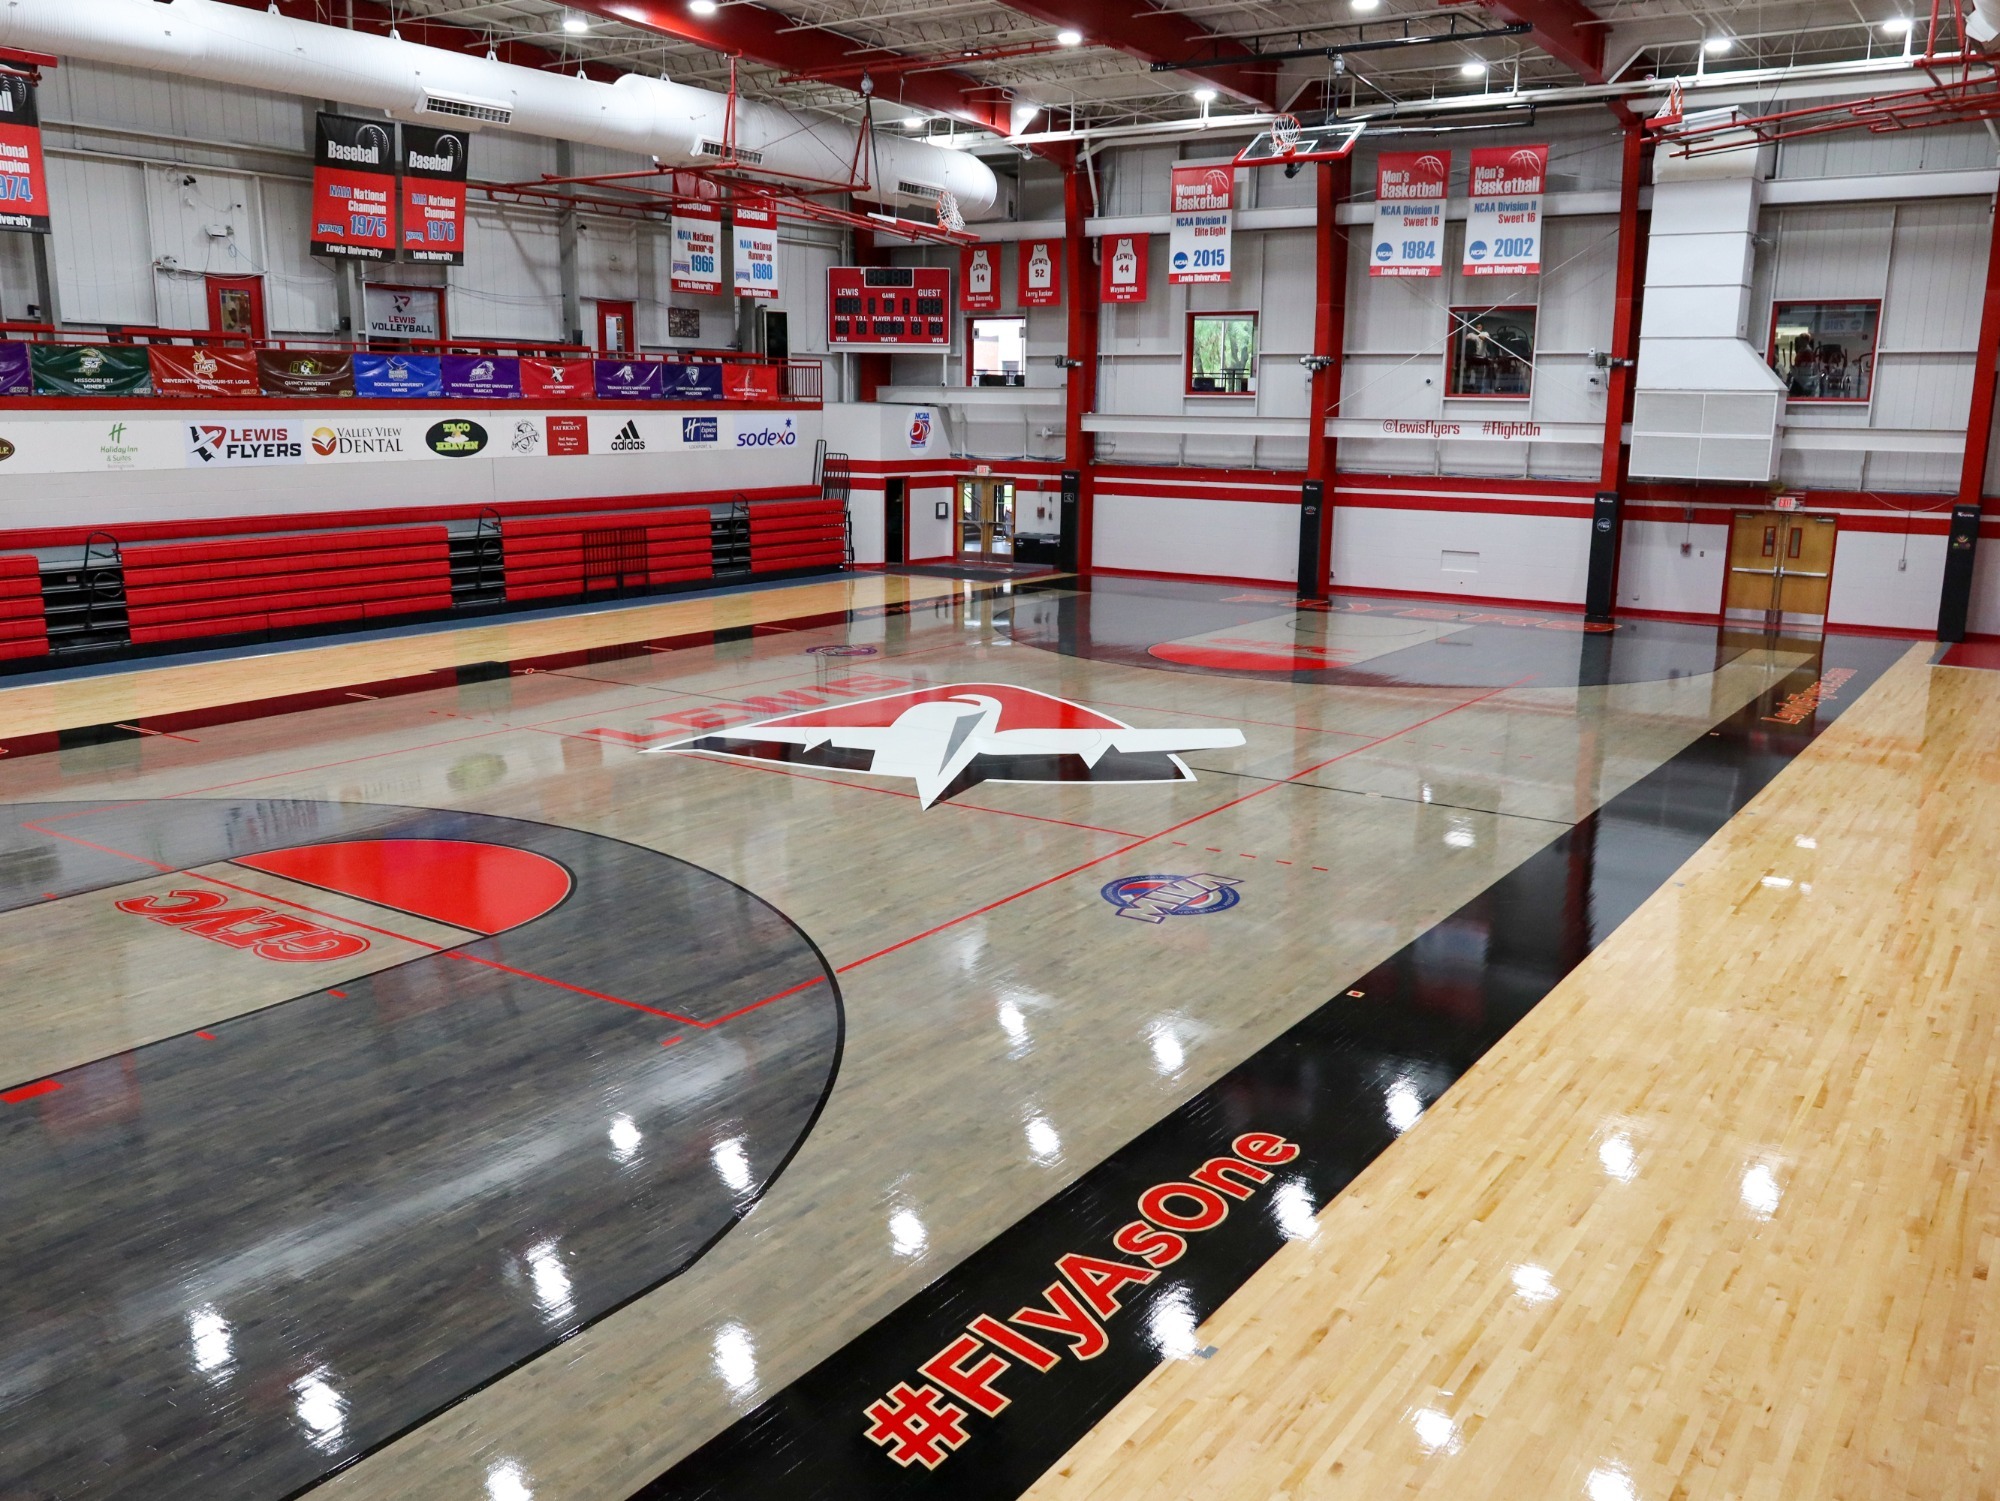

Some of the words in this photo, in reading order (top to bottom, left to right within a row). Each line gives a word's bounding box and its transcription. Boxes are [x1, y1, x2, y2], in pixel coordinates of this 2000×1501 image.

[328, 140, 379, 164] Baseball
[409, 150, 453, 172] Baseball
[1382, 170, 1410, 183] Men's
[1475, 165, 1504, 180] Men's
[1176, 183, 1212, 196] Women's
[1381, 181, 1442, 199] Basketball
[1474, 176, 1540, 195] Basketball
[330, 184, 351, 198] NAIA
[354, 188, 386, 202] National
[348, 200, 386, 215] Champion
[429, 195, 456, 207] National
[1176, 193, 1228, 211] Basketball
[1474, 202, 1495, 213] NCAA
[1498, 201, 1529, 212] Division
[424, 207, 455, 220] Champion
[1381, 205, 1400, 215] NCAA
[1403, 205, 1432, 215] Division
[1176, 217, 1194, 226] NCAA
[1195, 216, 1220, 226] Division
[1404, 217, 1428, 227] Sweet
[1431, 216, 1438, 226] 16
[1498, 213, 1525, 224] Sweet
[1528, 212, 1535, 222] 16
[350, 214, 386, 238] 1975
[427, 221, 455, 241] 1976
[1195, 227, 1208, 237] Elite
[1210, 227, 1226, 237] Eight
[677, 230, 691, 240] NAIA
[693, 232, 714, 243] National
[326, 244, 346, 254] Lewis
[348, 246, 382, 258] University
[753, 241, 772, 251] National
[1402, 240, 1435, 259] 1984
[1494, 238, 1534, 257] 2002
[413, 250, 427, 260] Lewis
[1194, 249, 1224, 267] 2015
[691, 254, 714, 273] 1966
[1032, 258, 1048, 266] LEWIS
[1119, 264, 1129, 273] 44
[752, 263, 772, 280] 1980
[1035, 269, 1044, 277] 52
[1381, 267, 1398, 275] Lewis
[1400, 267, 1429, 276] University
[1475, 266, 1493, 275] Lewis
[1494, 266, 1527, 275] University
[976, 274, 985, 282] 14
[372, 322, 433, 333] VOLLEYBALL
[231, 428, 288, 441] LEWIS
[337, 427, 373, 437] VALLEY
[375, 427, 402, 436] VIEW
[443, 424, 470, 432] TACO
[1383, 419, 1460, 438] @LewisFlyers
[1482, 421, 1540, 439] #FlightOn
[736, 428, 796, 447] sodexo
[226, 443, 302, 458] FLYERS
[339, 438, 403, 454] DENTAL
[436, 441, 479, 451] HEAVEN
[611, 440, 645, 450] adidas
[1779, 498, 1792, 507] EXIT
[581, 676, 912, 742] LEWIS
[114, 889, 371, 962] GLVC
[862, 1132, 1301, 1471] #FlyAsOne
